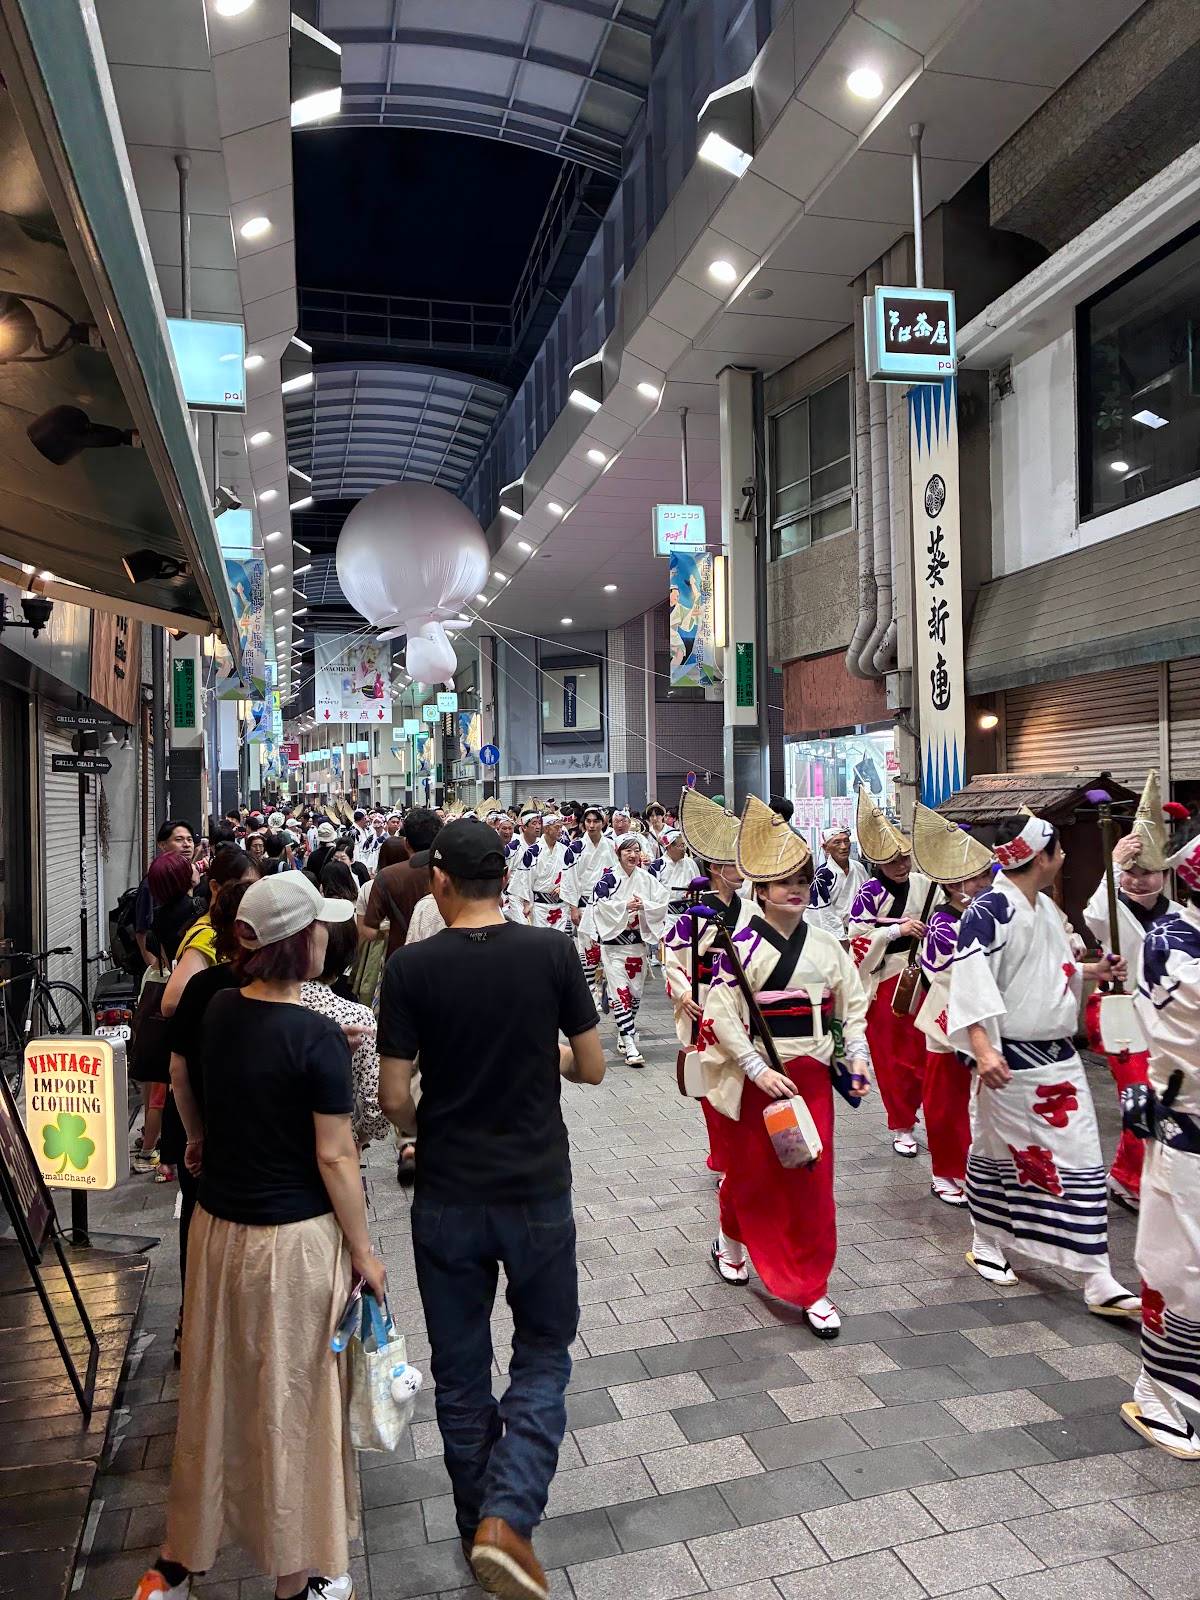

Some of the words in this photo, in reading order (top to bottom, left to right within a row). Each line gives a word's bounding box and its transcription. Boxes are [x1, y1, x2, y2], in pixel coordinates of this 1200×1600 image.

[888, 309, 948, 345] そば茶屋
[938, 358, 956, 371] pal
[225, 389, 243, 401] pal
[663, 511, 700, 519] クリーニング
[925, 530, 952, 711] 葵新連
[27, 1053, 103, 1077] VINTAGE
[34, 1078, 97, 1095] IMPORT
[32, 1095, 101, 1114] CLOTHING
